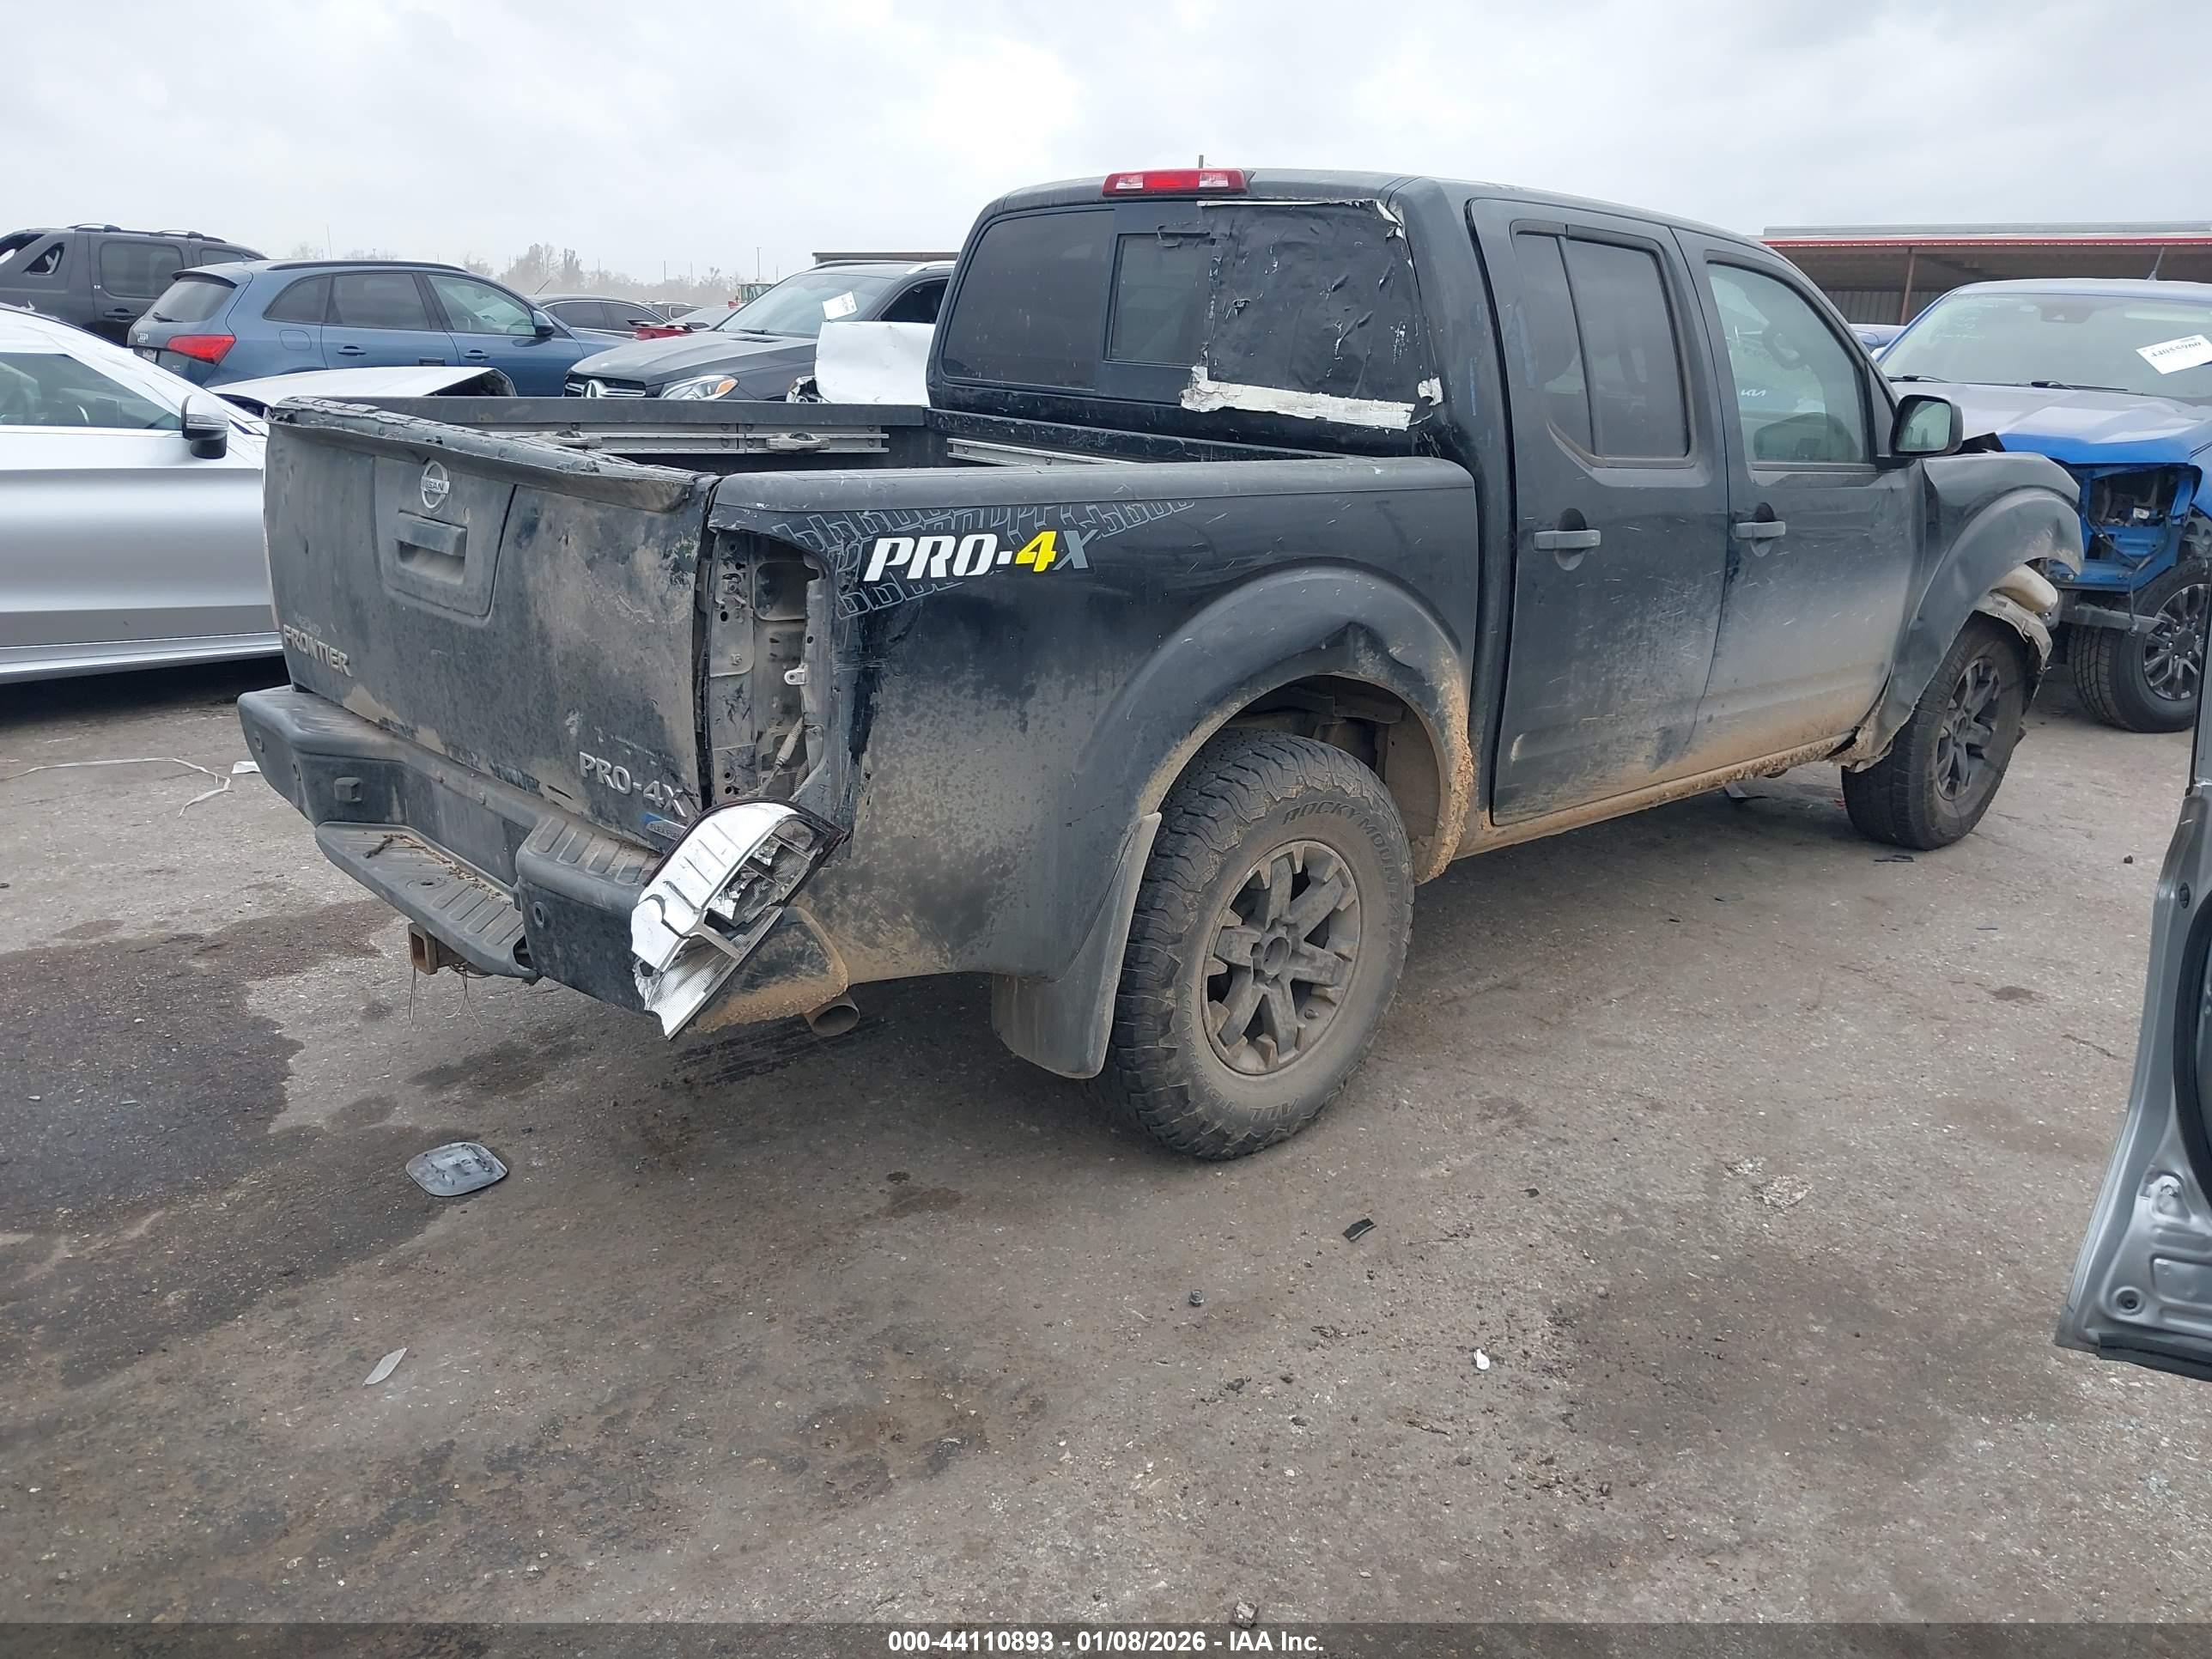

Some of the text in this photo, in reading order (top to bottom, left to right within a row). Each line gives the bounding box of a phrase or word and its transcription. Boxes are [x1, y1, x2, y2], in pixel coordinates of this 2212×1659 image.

[1741, 388, 1766, 397] KIA
[862, 529, 1099, 582] PRO-4X
[283, 623, 354, 678] FRONTIER
[579, 750, 687, 817] PRO-4X
[1282, 800, 1360, 825] ROCKY
